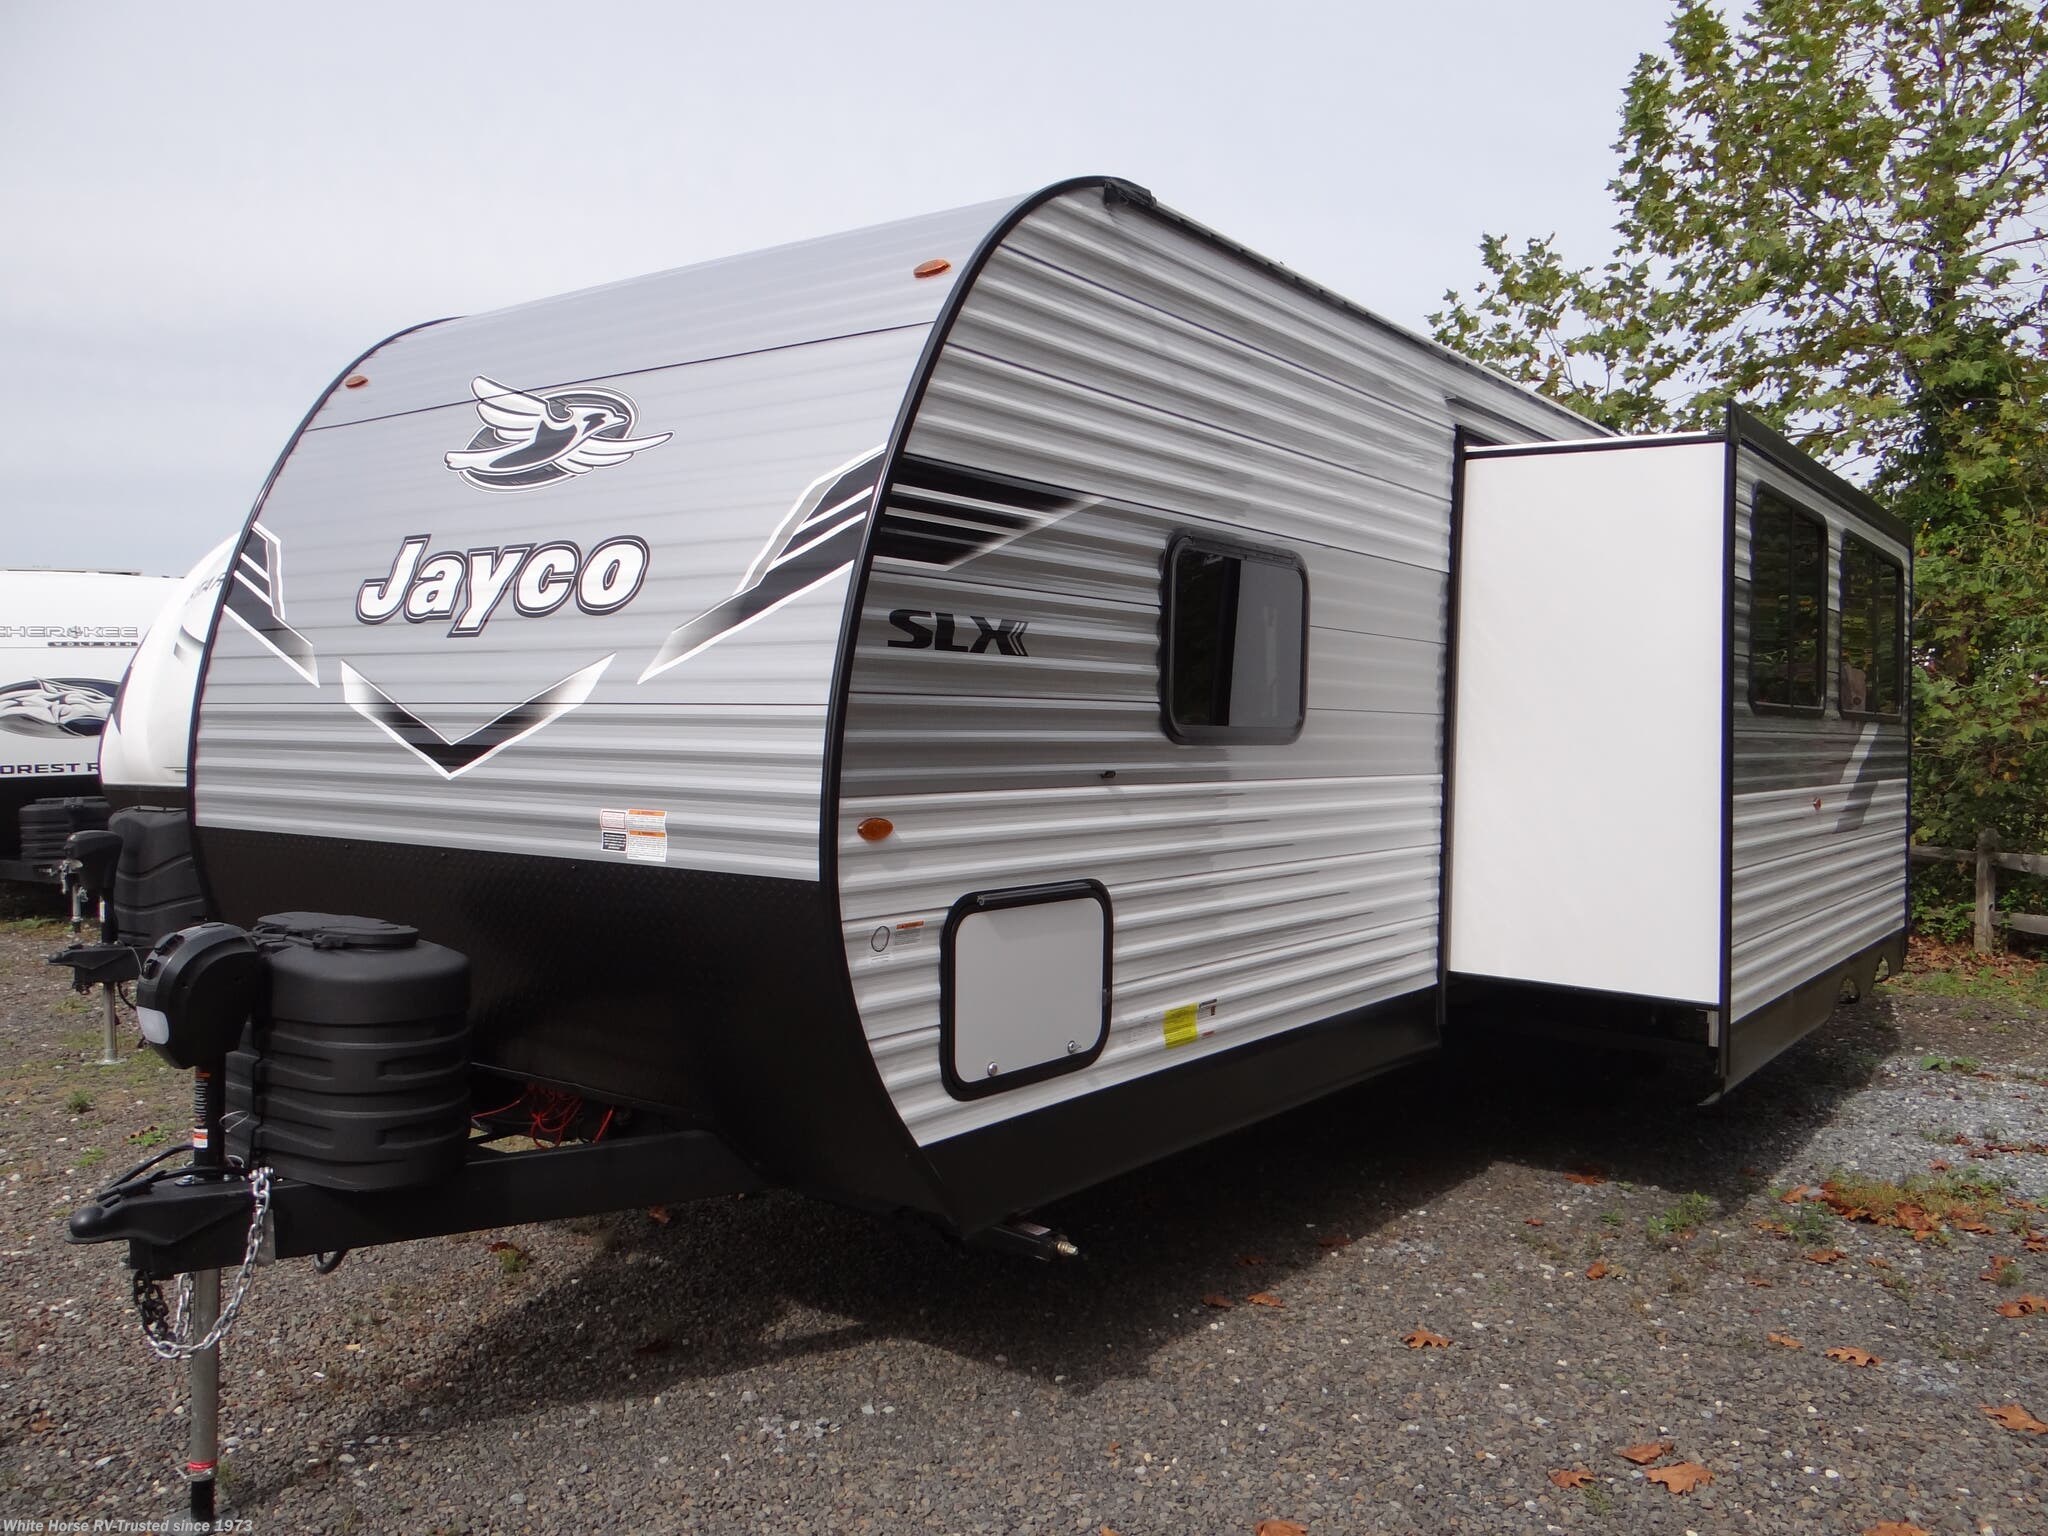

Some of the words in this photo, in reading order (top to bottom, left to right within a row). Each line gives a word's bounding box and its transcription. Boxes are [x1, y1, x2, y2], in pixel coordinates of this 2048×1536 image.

[356, 533, 650, 638] Jayco
[0, 626, 138, 639] HEROKEE
[887, 608, 1029, 657] SLX
[0, 762, 80, 775] OREST
